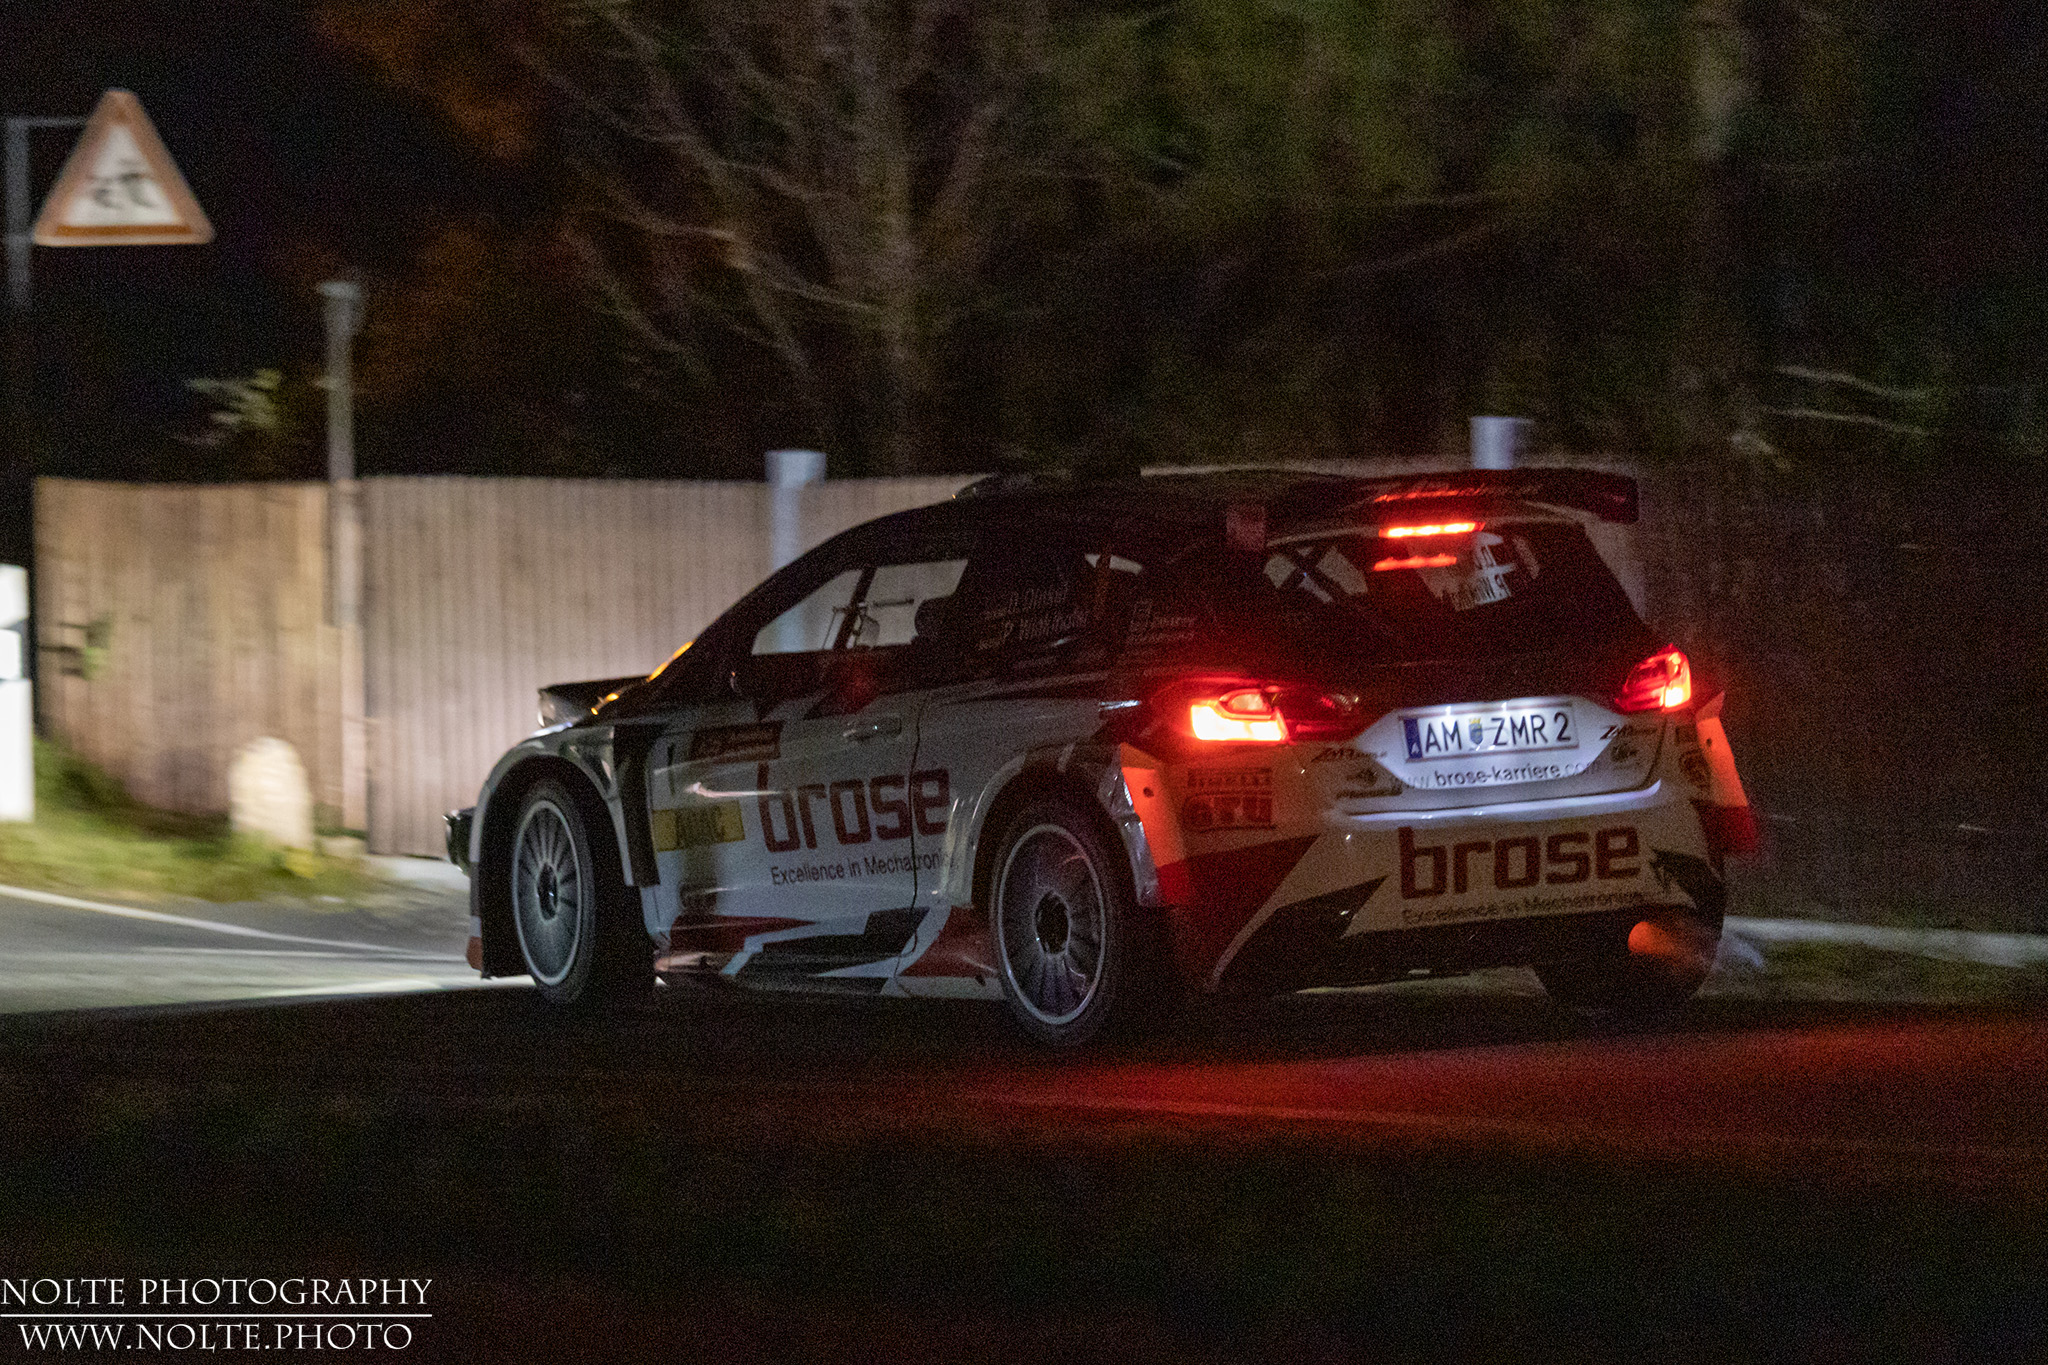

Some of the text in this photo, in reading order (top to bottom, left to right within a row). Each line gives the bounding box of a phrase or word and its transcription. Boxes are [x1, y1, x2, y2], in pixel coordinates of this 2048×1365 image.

[1425, 720, 1462, 752] AM
[1491, 714, 1548, 746] ZMR
[1553, 711, 1572, 742] 2
[757, 761, 951, 853] brose
[771, 862, 844, 886] Excellence
[850, 859, 863, 876] in
[1399, 826, 1641, 900] brose
